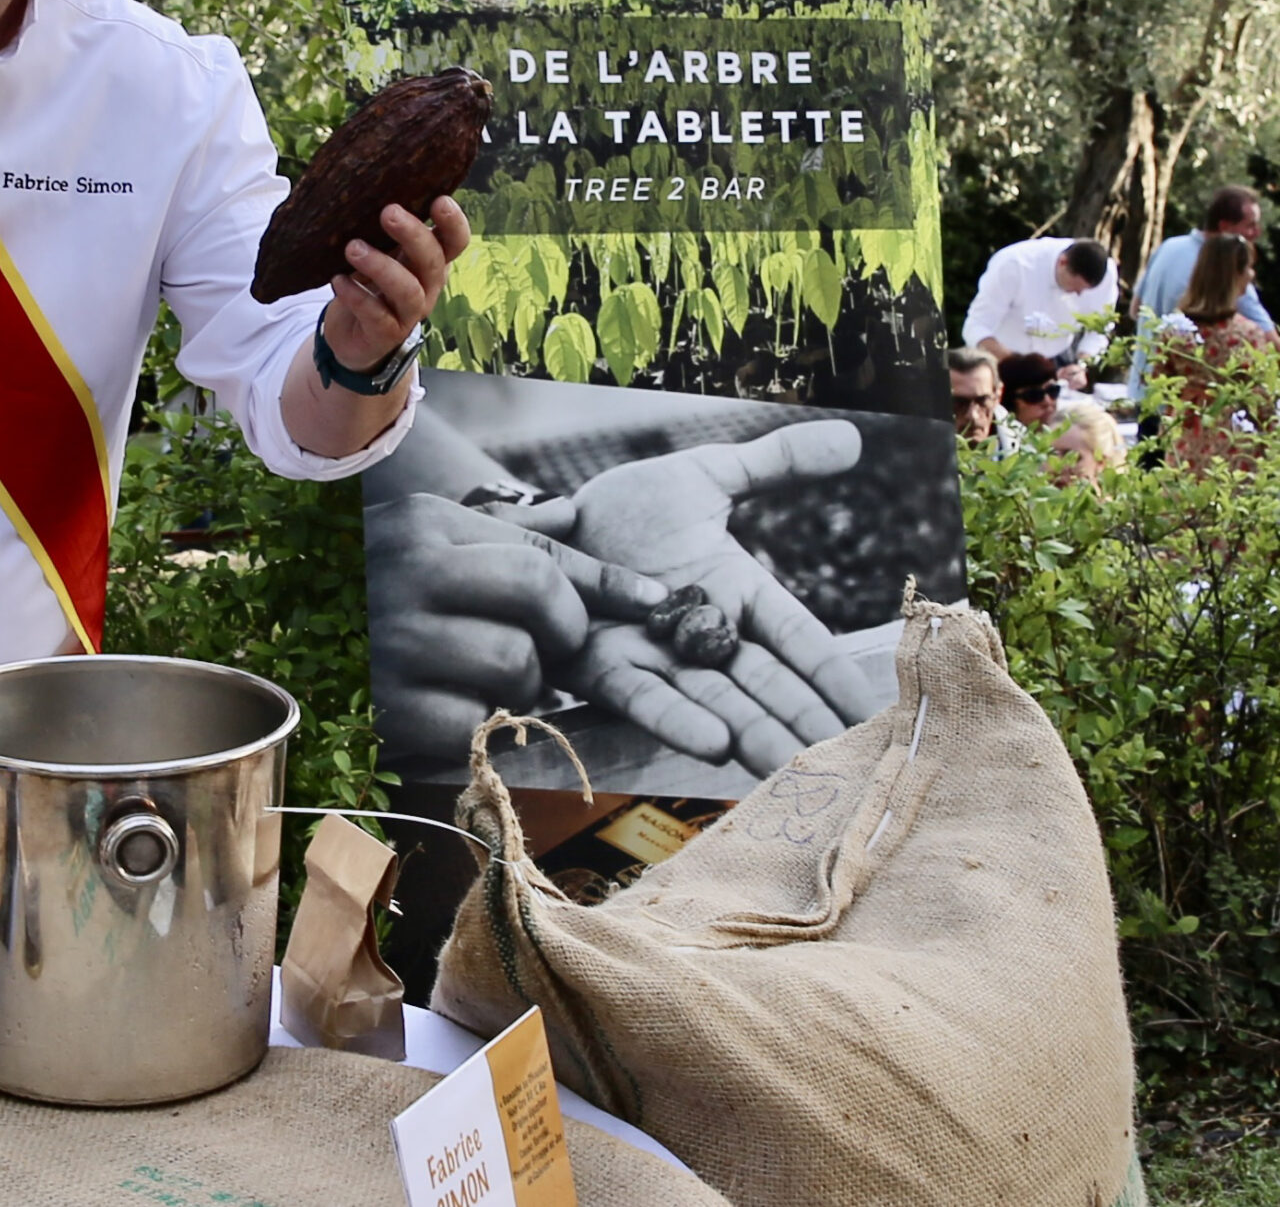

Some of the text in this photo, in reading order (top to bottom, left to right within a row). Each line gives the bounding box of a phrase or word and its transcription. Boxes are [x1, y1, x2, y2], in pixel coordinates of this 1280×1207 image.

[509, 49, 570, 84] DE
[518, 111, 578, 144] LA
[604, 110, 864, 144] TABLETTE
[2, 171, 134, 194] Fabrice Simon
[565, 177, 766, 202] TREE 2 BAR
[427, 1128, 482, 1190] Fabrice
